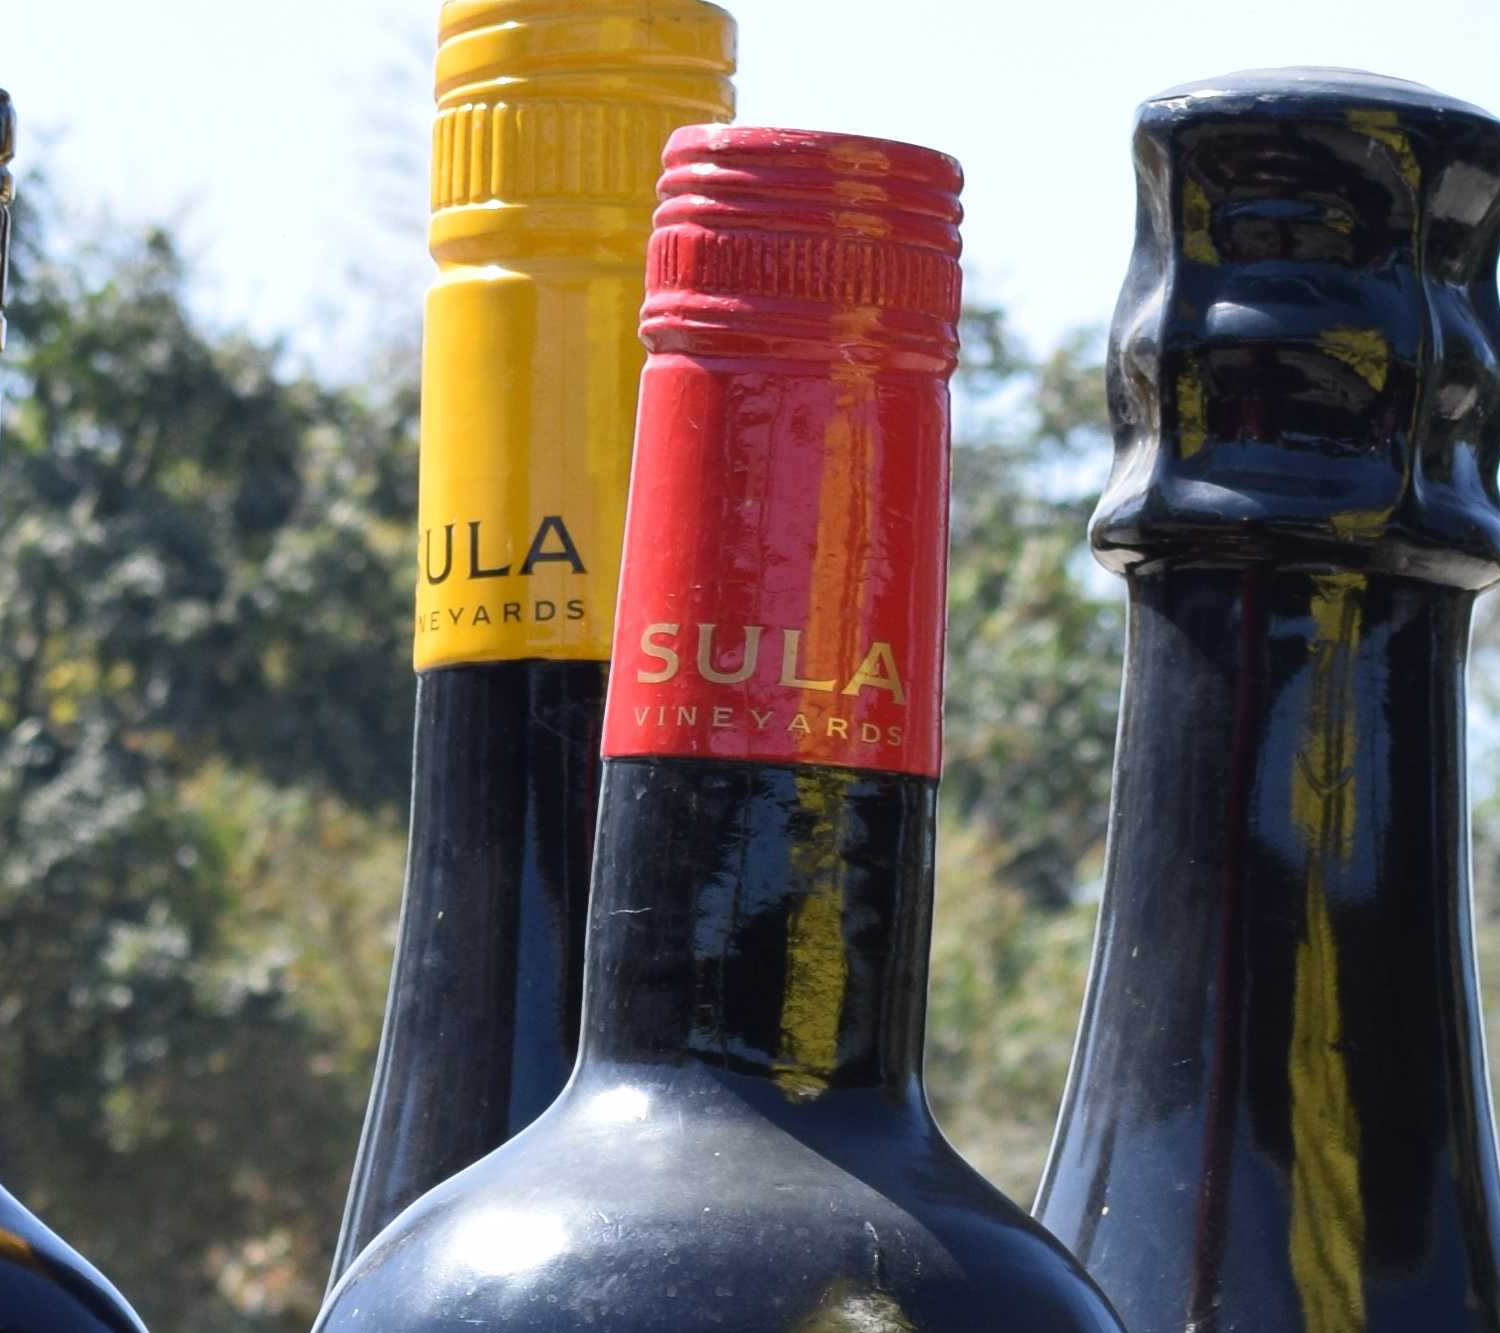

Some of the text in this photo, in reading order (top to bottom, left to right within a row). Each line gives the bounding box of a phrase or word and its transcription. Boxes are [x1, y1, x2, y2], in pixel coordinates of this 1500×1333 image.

[421, 516, 588, 586] ULA
[418, 600, 586, 633] NEYARDS
[635, 622, 907, 704] SULA
[633, 705, 904, 747] VINEYARDS
